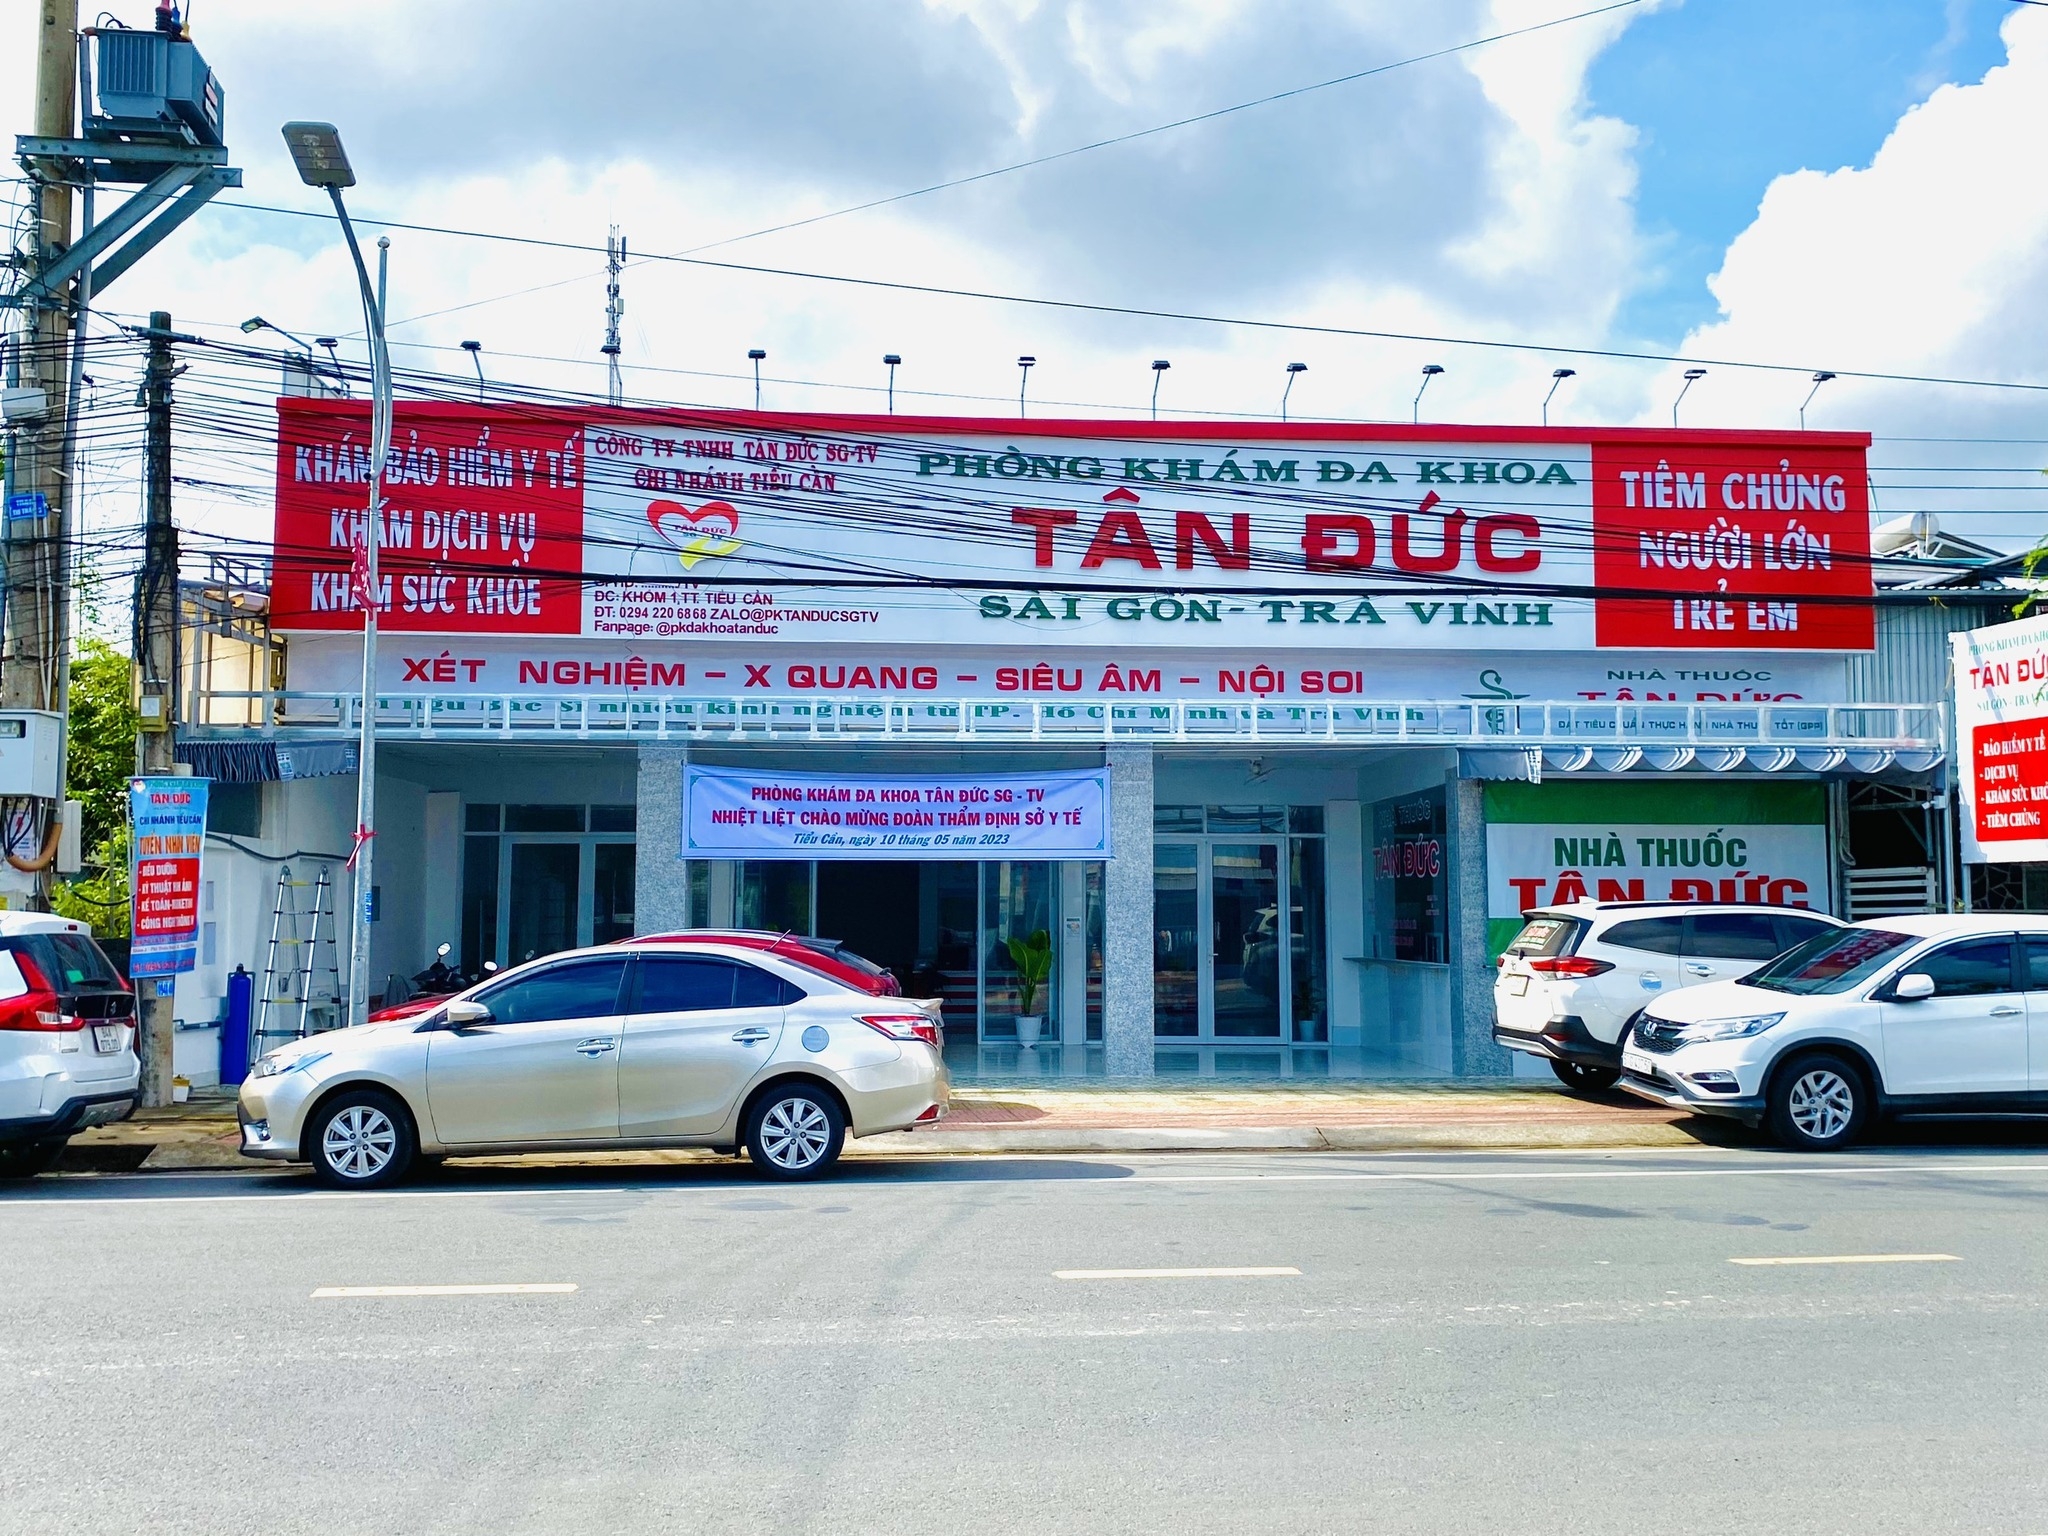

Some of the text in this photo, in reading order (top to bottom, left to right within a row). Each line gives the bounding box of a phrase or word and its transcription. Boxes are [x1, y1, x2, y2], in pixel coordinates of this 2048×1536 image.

[385, 430, 440, 486] BẢO
[448, 425, 513, 487] HIỂM
[520, 449, 538, 487] Y
[546, 431, 580, 489] TẾ
[595, 432, 643, 456] CÔNG
[652, 439, 676, 457] TY
[683, 440, 734, 458] TNHH
[743, 437, 779, 460] TÂN
[785, 434, 819, 460] ĐỨC
[634, 468, 667, 488] CHI
[915, 445, 1577, 485] PHÒNG KHÁM ĐA KHOA
[1620, 458, 1846, 512] TIÊM CHỦNG
[423, 509, 488, 561] DỊCH
[499, 511, 536, 563] VỤ
[1010, 486, 1542, 573] TÂN ĐỨC
[1638, 516, 1832, 571] NGƯỜI LỚN
[594, 590, 619, 602] ĐC:
[594, 606, 616, 618] ĐT:
[619, 606, 648, 618] 0294
[652, 607, 674, 619] 220
[1405, 602, 1554, 626] VINH
[1748, 601, 1798, 631] EM
[594, 620, 779, 636] Fanpage: @pkdakhoatanduc
[402, 650, 486, 684] XÉT
[519, 655, 686, 692] NGHIỆM
[744, 665, 773, 689] X
[787, 665, 938, 690] QUANG
[995, 661, 1083, 693] SIÊU
[1098, 662, 1161, 693] ÂM
[1219, 664, 1285, 698] NỘI
[1300, 670, 1363, 694] SOI
[1607, 668, 1667, 681] NHÀ
[1969, 647, 2048, 690] TÂN ĐỨ
[1149, 706, 1228, 720] Mnh
[2026, 737, 2033, 752] Y
[1984, 764, 2019, 784] DỊCH VỤ
[752, 784, 802, 801] PHÒNG
[807, 785, 851, 802] KHÁM
[855, 789, 876, 802] ĐA
[880, 789, 920, 803] KHOA
[924, 786, 954, 803] TÂN
[959, 786, 989, 803] ĐỨC
[993, 789, 1013, 803] SG
[1025, 788, 1045, 803] TV
[712, 806, 1084, 829] NHIỆT LIỆT CHÀO MỪNG ĐOÀN THẨM ĐỊNH SỞ Y TẾ
[793, 832, 1010, 847] Tiểu Cần, ngày 10 tháng 05 năm 2023
[1553, 828, 1748, 868] NHÀ THUỐC
[1403, 833, 1440, 878] ĐỨC
[1509, 870, 1809, 914] TÂN ĐỨC
